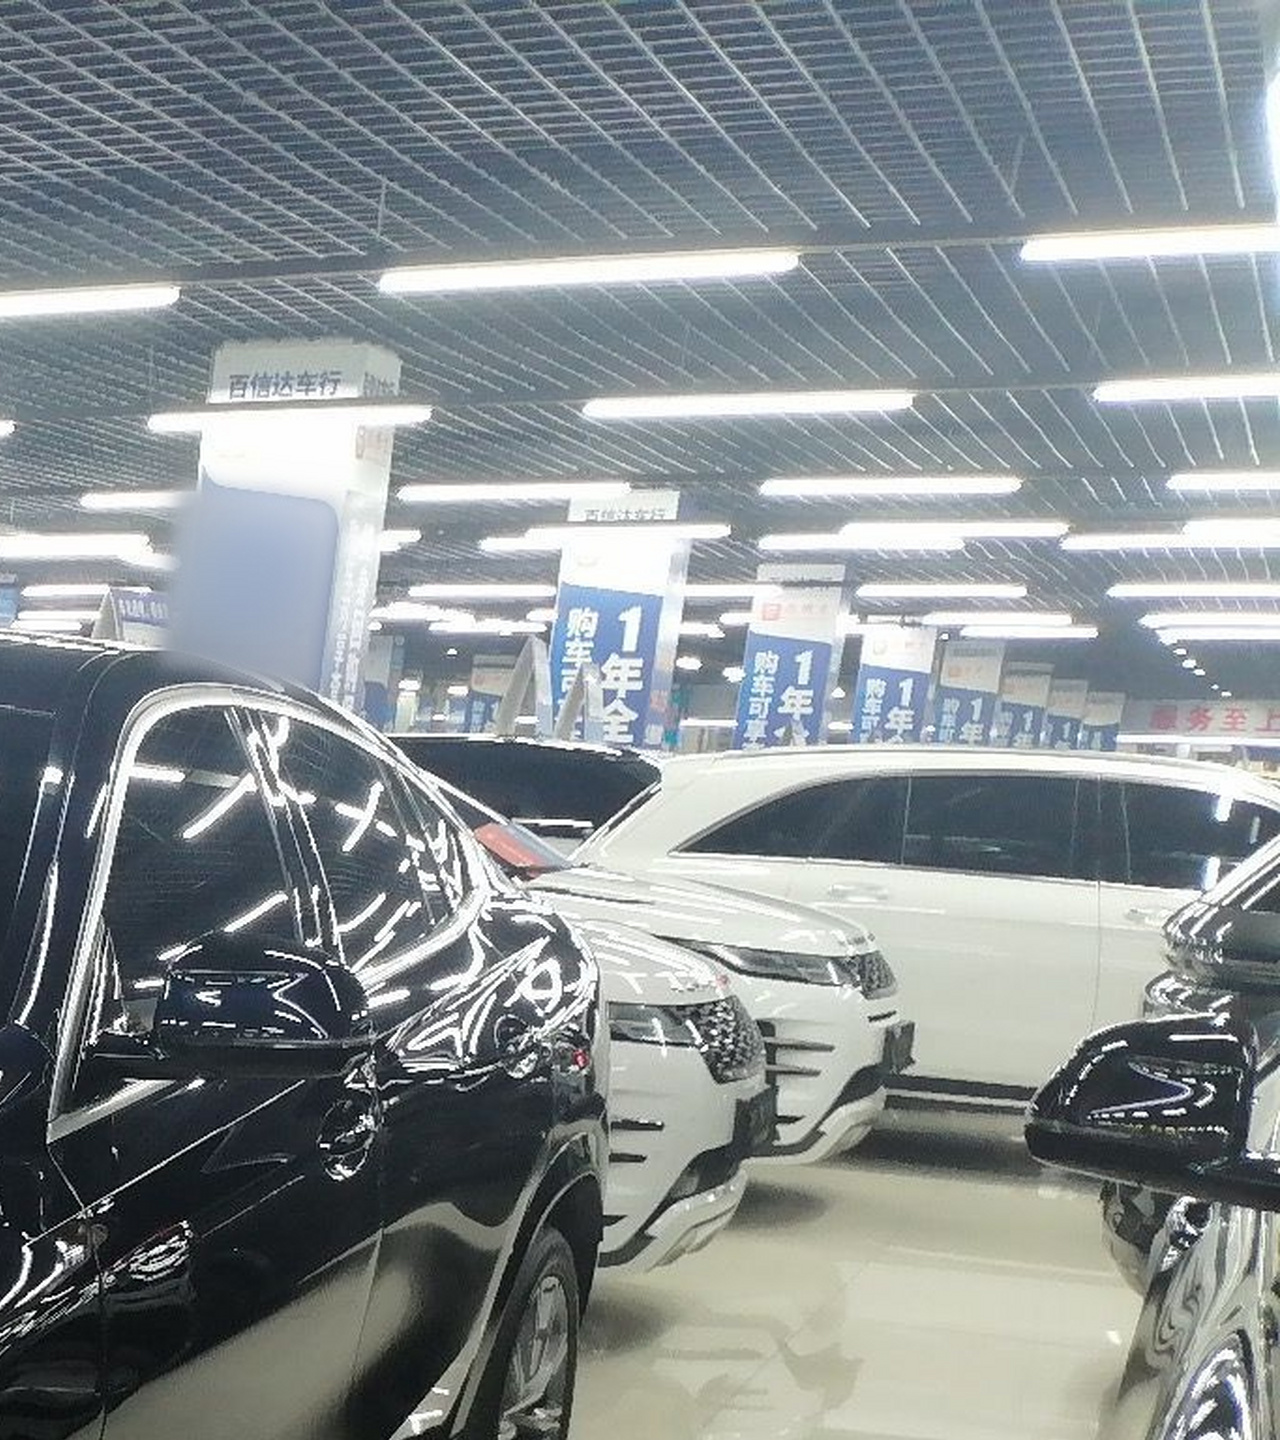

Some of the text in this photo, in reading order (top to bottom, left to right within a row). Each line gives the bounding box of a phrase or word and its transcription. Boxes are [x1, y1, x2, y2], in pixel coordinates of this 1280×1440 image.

[228, 369, 343, 400] 百信达车行
